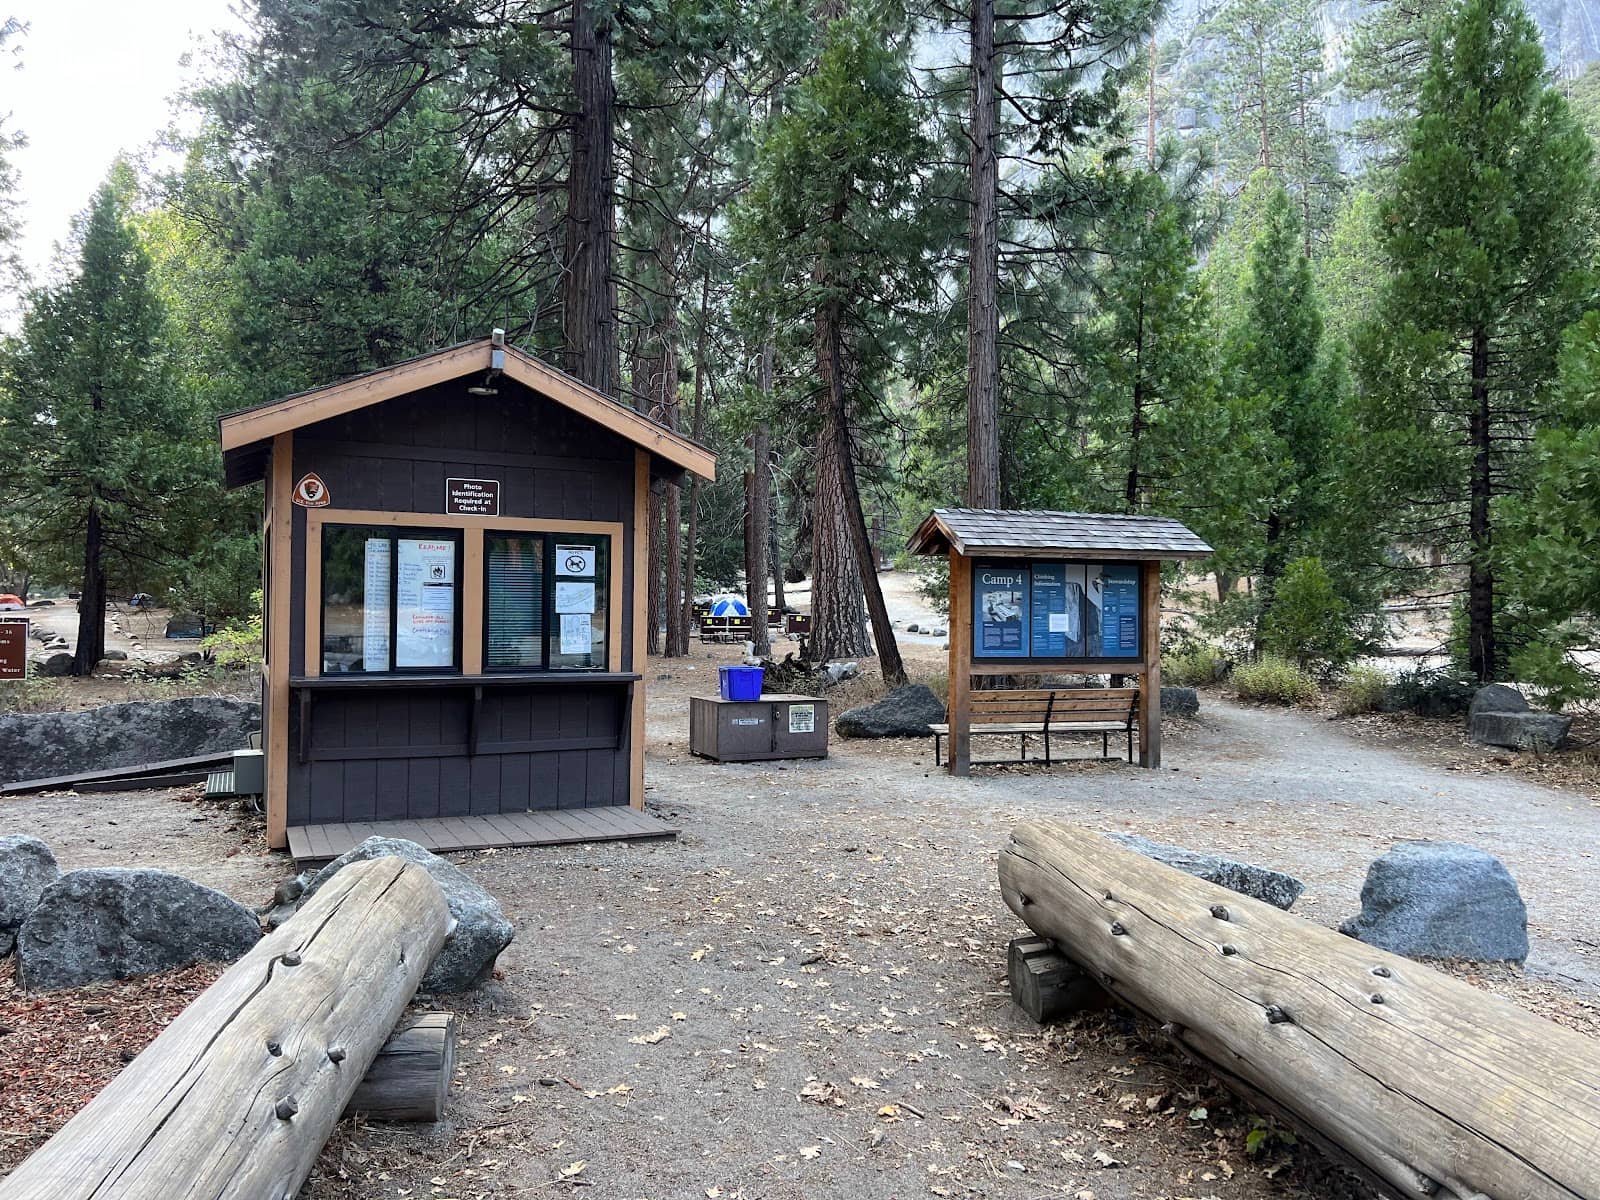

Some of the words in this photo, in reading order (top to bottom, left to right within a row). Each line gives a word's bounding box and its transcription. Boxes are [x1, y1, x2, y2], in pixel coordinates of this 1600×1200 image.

[452, 490, 494, 498] Identification
[454, 497, 482, 505] Required
[982, 573, 1014, 588] Camp
[1016, 574, 1022, 585] 4
